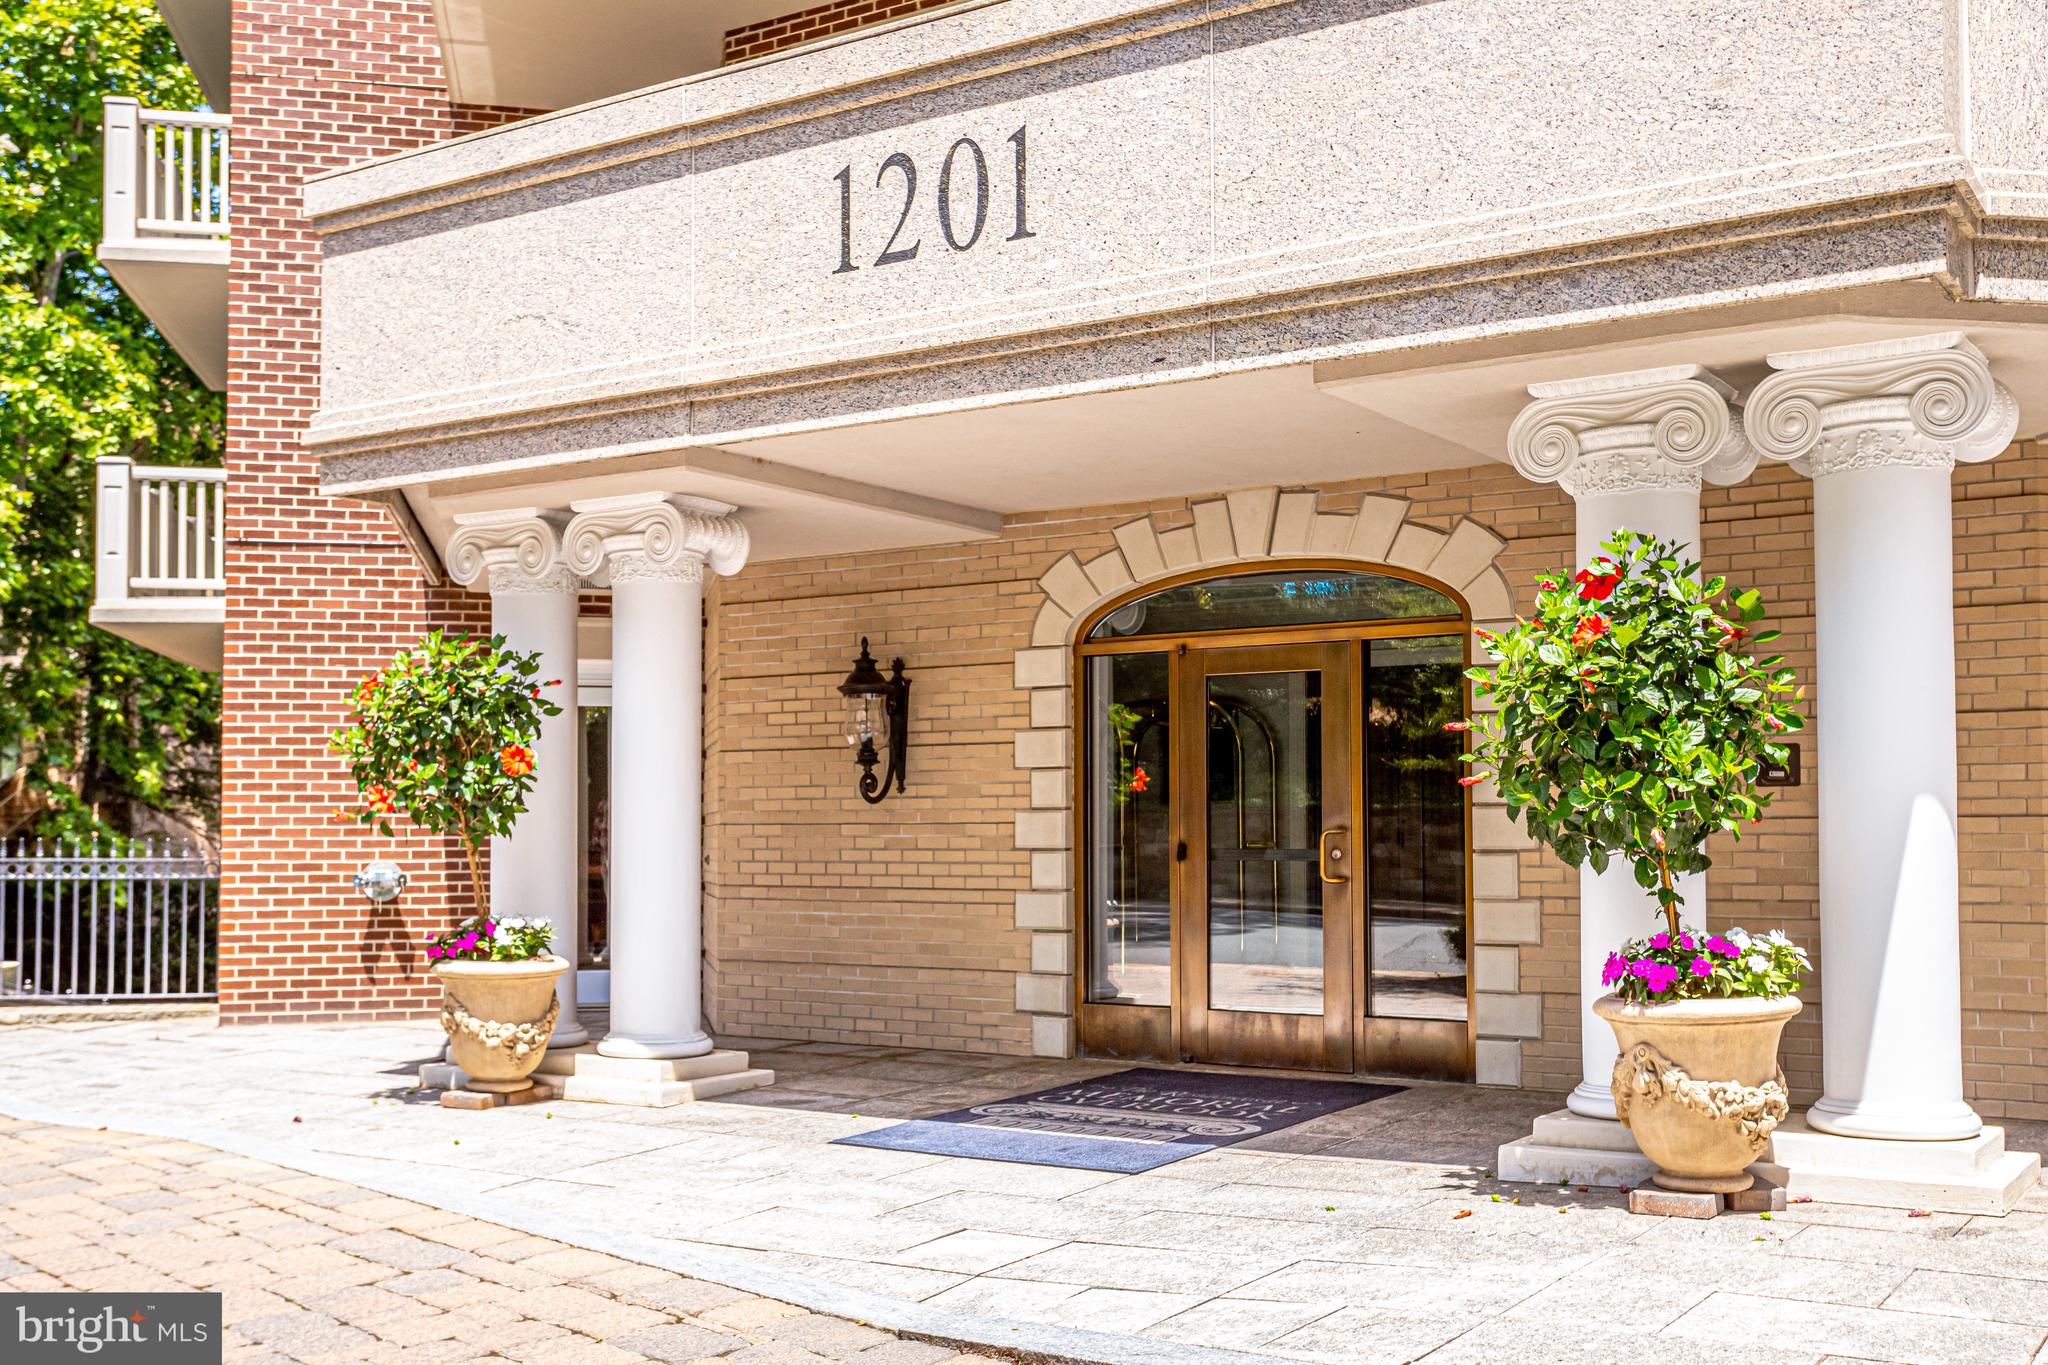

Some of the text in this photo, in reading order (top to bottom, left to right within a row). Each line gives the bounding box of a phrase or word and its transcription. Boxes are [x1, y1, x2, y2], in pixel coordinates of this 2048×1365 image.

[832, 123, 1037, 275] 1201
[1037, 1095, 1271, 1121] OVERLOOK
[1058, 1089, 1300, 1114] MEMORIAL
